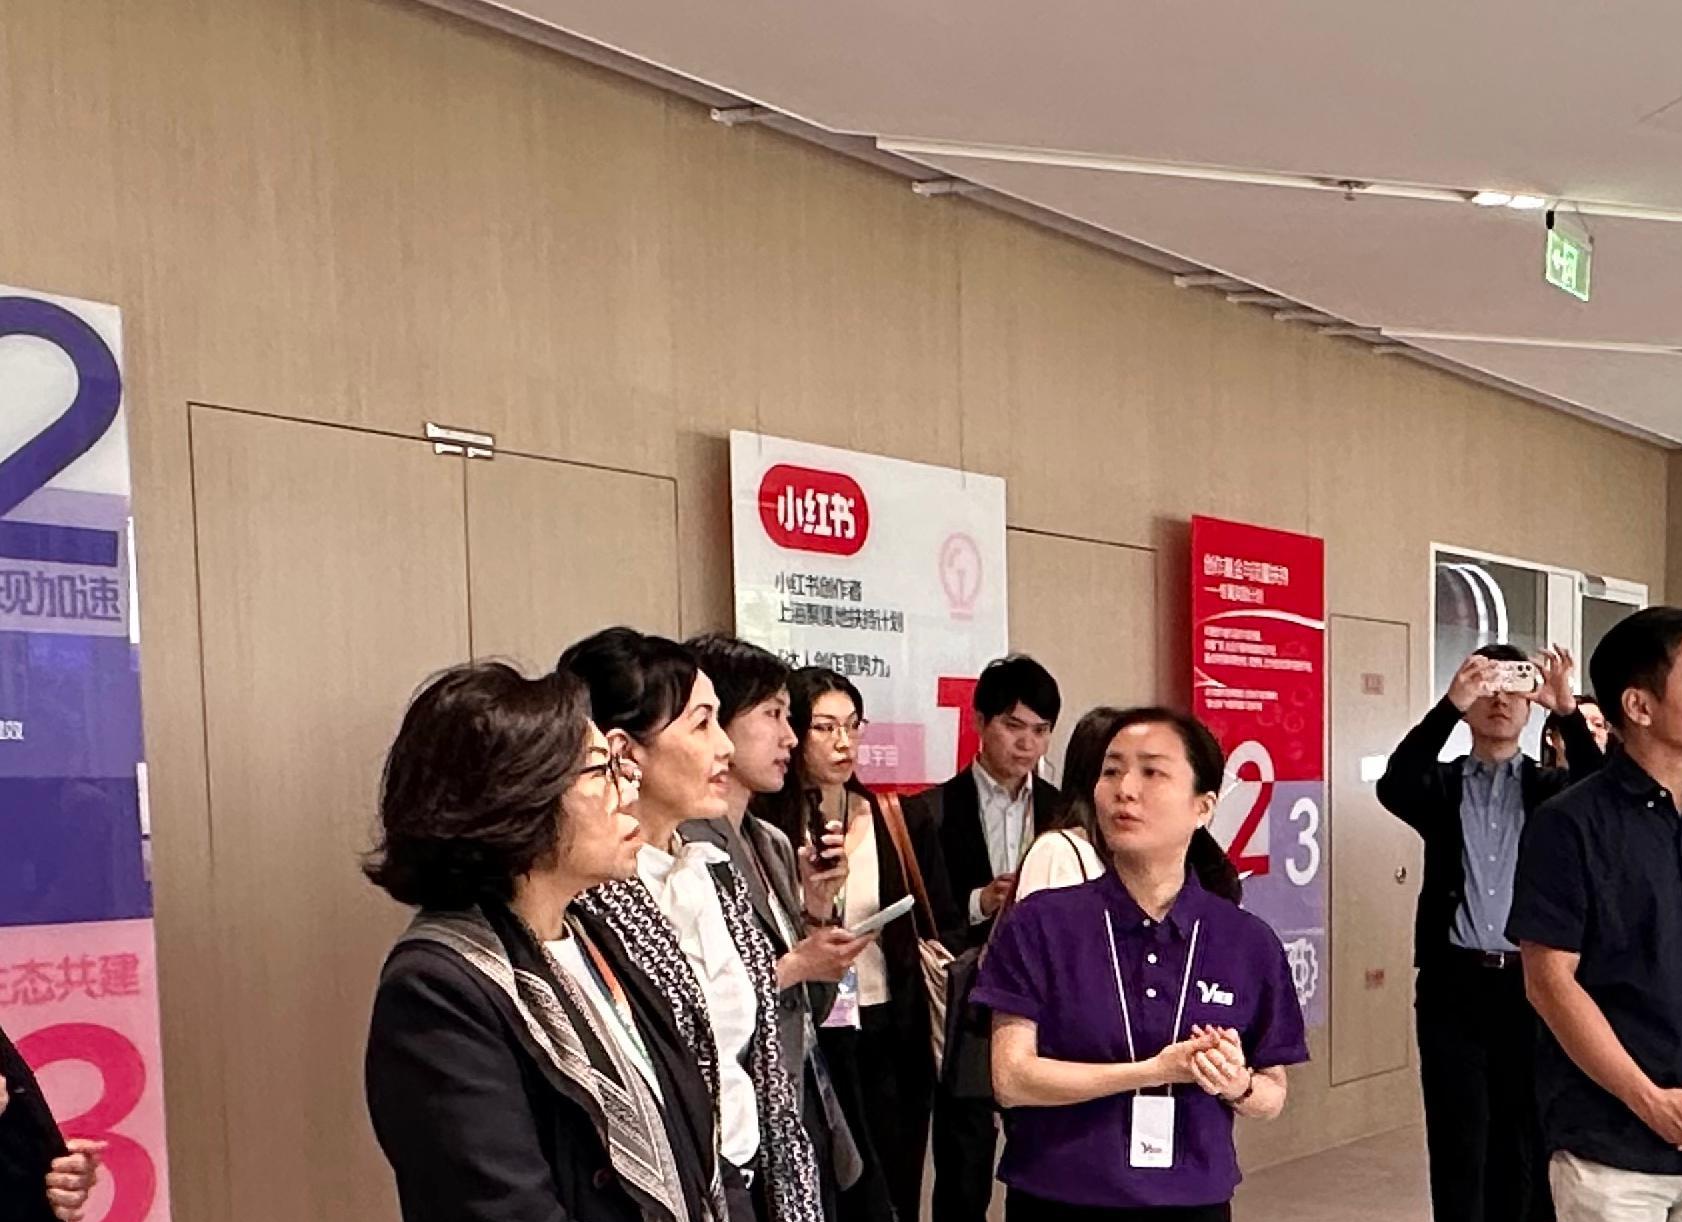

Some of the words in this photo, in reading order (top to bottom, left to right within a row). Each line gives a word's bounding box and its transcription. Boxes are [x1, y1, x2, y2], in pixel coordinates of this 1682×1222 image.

[777, 485, 856, 540] 小红书
[1285, 797, 1321, 886] 3
